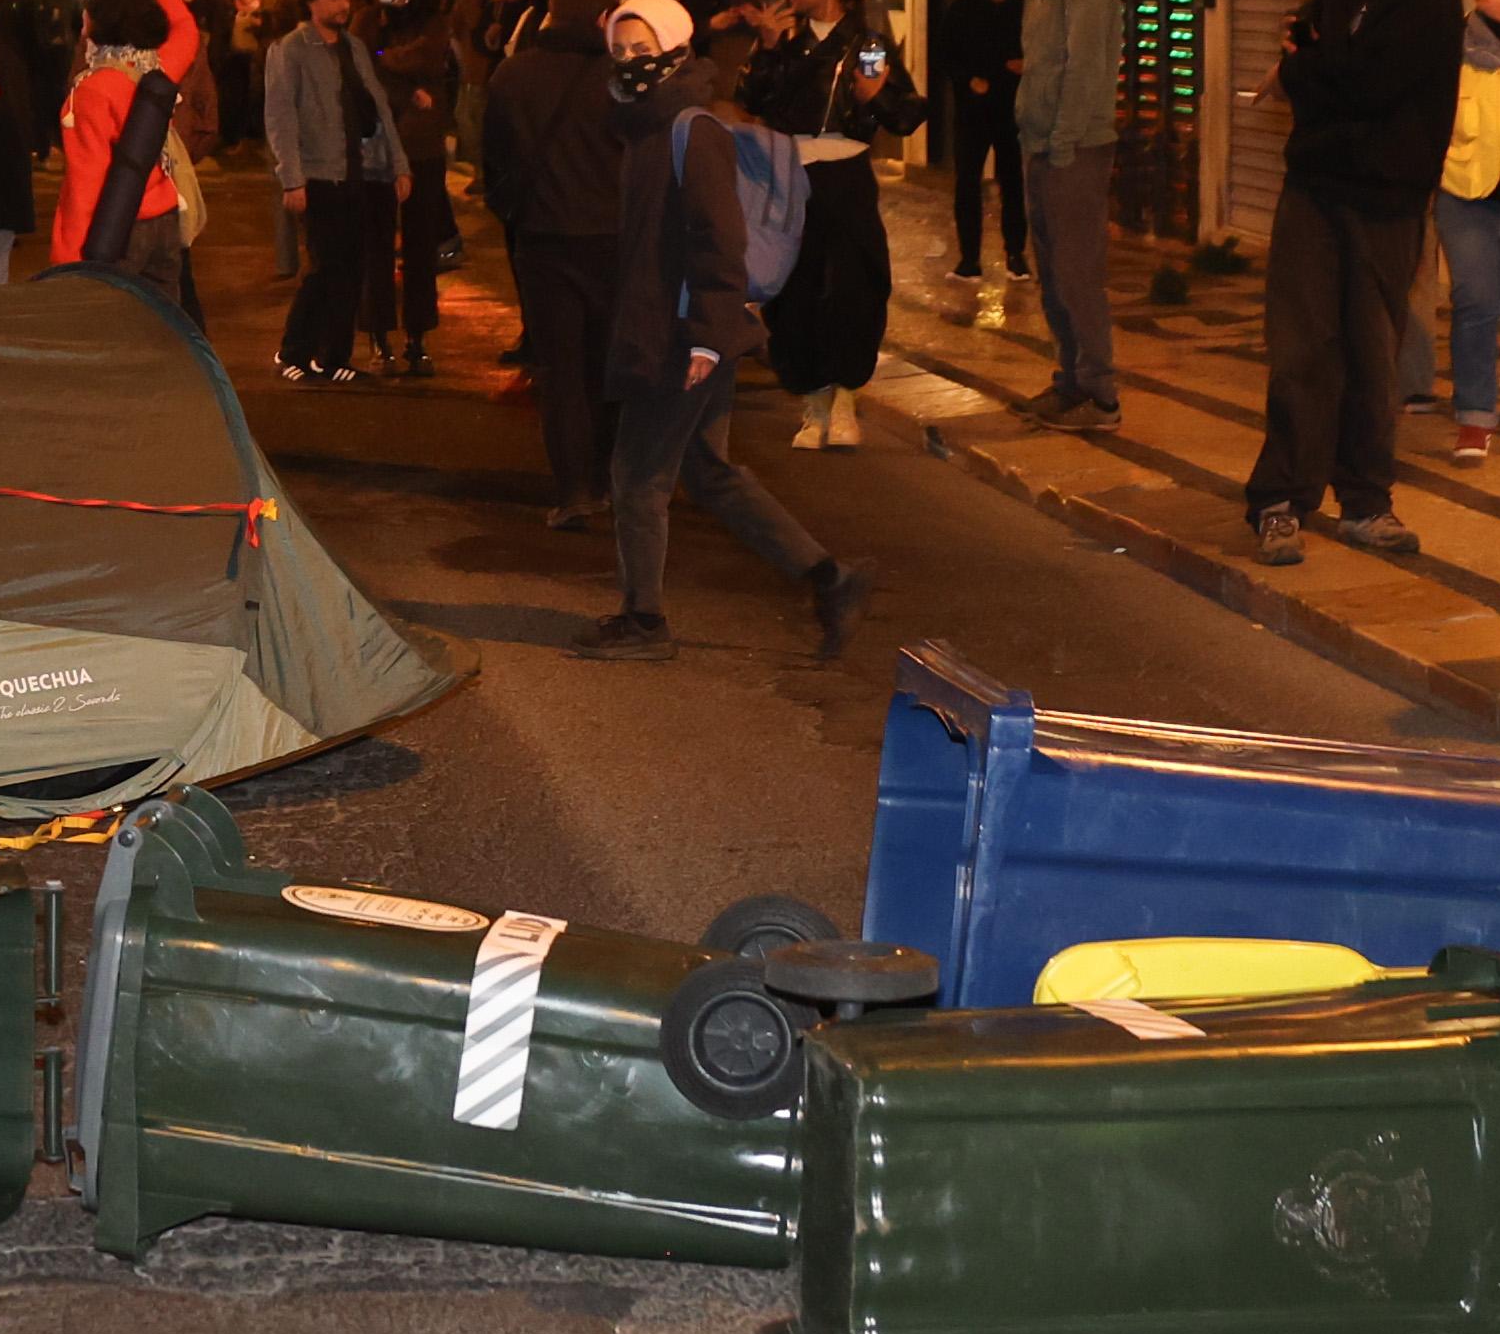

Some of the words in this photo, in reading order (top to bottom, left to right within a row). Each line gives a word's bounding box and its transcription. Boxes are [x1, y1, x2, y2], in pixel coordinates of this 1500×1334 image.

[0, 668, 93, 698] QUECHUA
[16, 703, 51, 718] classic
[53, 696, 64, 713] 2
[69, 688, 121, 712] Seconds
